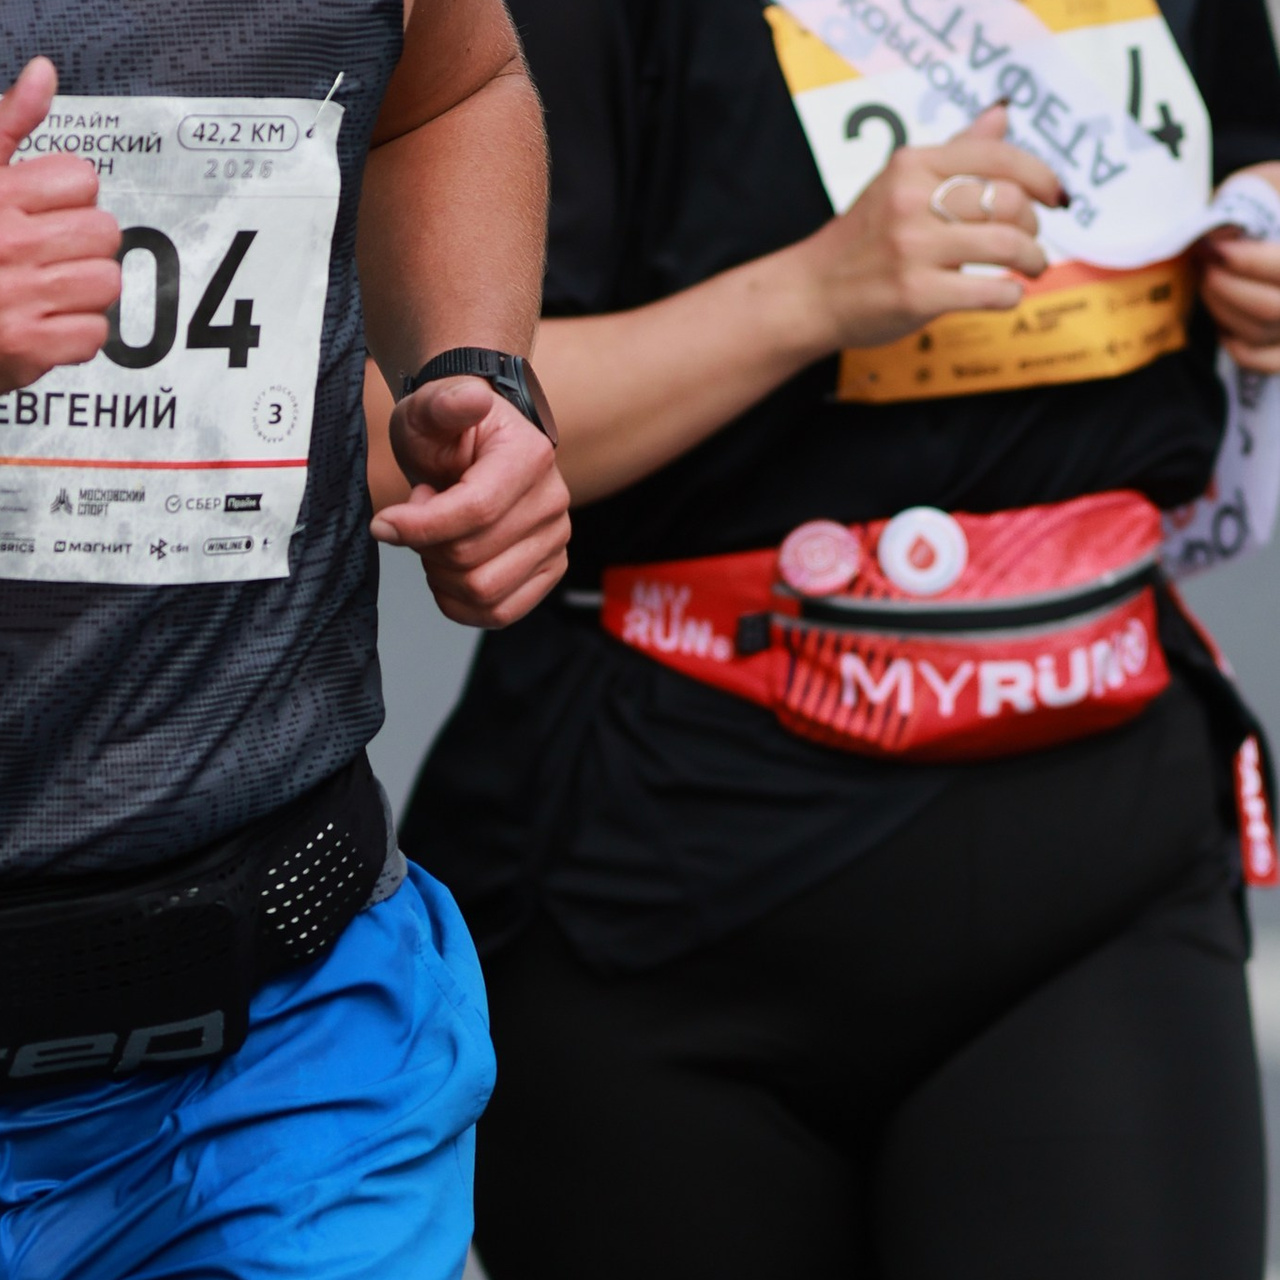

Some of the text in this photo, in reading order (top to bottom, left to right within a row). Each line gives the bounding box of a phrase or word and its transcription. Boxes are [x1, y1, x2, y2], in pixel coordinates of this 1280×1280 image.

[16, 131, 162, 154] ОСКОВСКИЙ
[191, 122, 286, 145] 42,2 КМ
[100, 225, 262, 370] 04
[267, 402, 283, 426] 3
[185, 496, 222, 511] СБЕР
